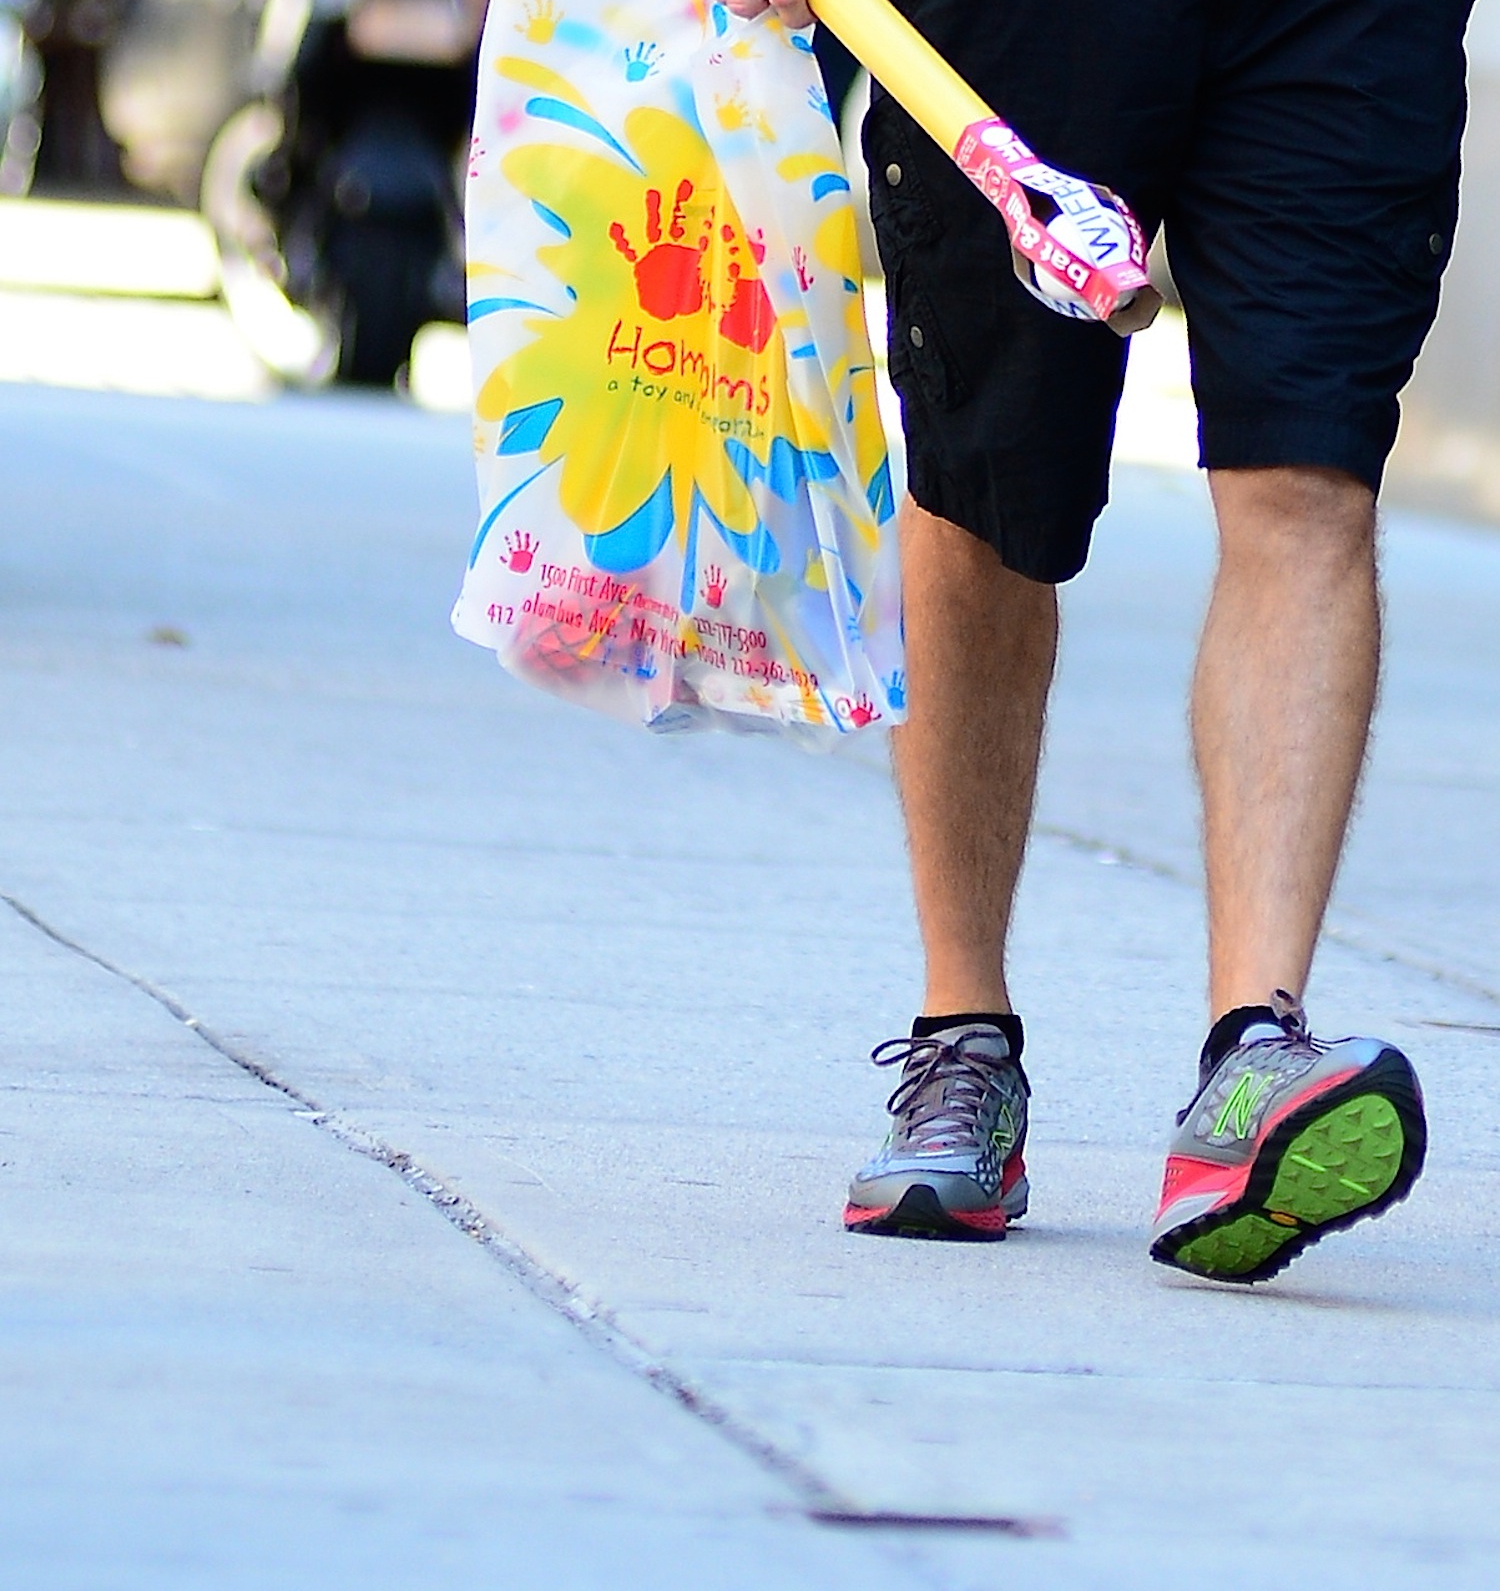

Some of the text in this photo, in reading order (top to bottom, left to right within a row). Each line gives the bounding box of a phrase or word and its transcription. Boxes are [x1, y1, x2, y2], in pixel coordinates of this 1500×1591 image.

[1020, 224, 1040, 249] &
[1040, 241, 1091, 290] bat
[607, 380, 618, 391] a
[631, 376, 667, 401] toy
[540, 563, 567, 589] 1500
[568, 566, 598, 597] First
[523, 592, 583, 628] olumbus
[588, 609, 618, 638] Ave.
